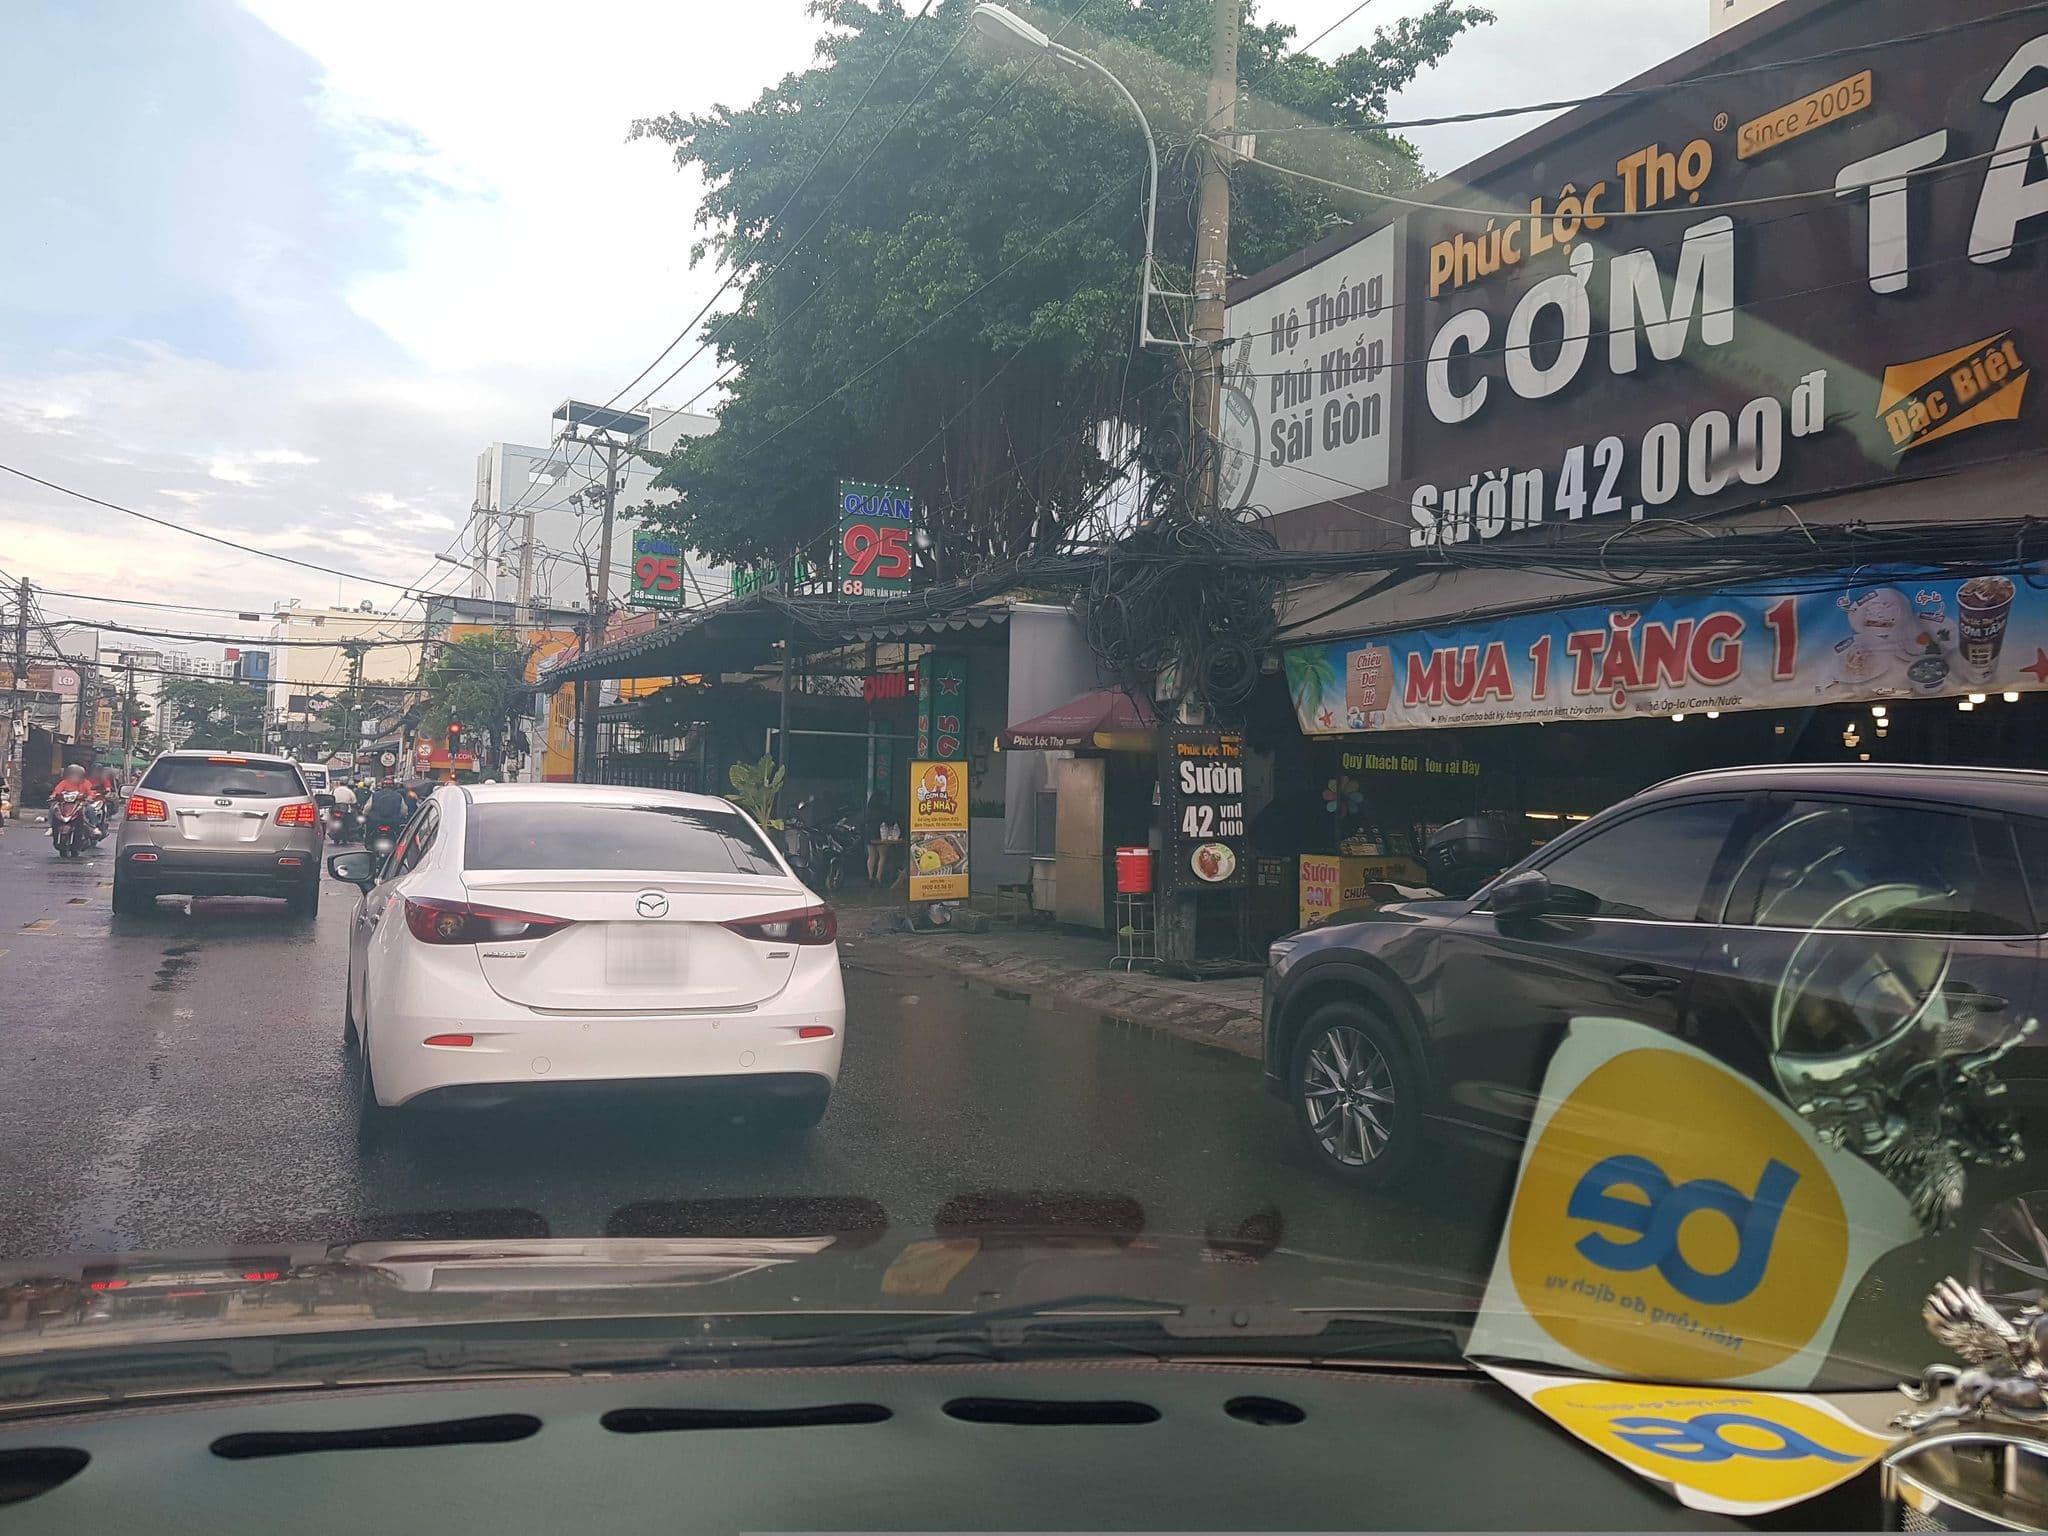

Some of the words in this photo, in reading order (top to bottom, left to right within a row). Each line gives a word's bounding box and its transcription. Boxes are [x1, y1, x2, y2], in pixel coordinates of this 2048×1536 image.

[1742, 112, 1799, 151] Since
[1804, 78, 1866, 127] 2005
[1429, 217, 1521, 298] Phúc
[1529, 182, 1606, 256] Lộc
[1616, 138, 1713, 215] Thọ
[1270, 307, 1300, 356] Hệ
[1306, 275, 1384, 340] Thống
[1426, 215, 1734, 424] CƠM
[1270, 358, 1313, 415] Phủ
[1319, 332, 1384, 397] Khắp
[1885, 387, 1949, 446] Đặc
[1951, 337, 2025, 406] Biệt
[1270, 408, 1314, 468] Sài
[1322, 392, 1382, 452] Gòn
[844, 491, 912, 520] QUÁN
[1409, 466, 1544, 548] Sườn
[635, 556, 681, 592] 95
[843, 524, 911, 578] 95
[634, 590, 645, 599] 68
[843, 580, 864, 595] 68
[1403, 640, 1516, 708] MUA
[1528, 635, 1553, 700] 1
[1565, 611, 1746, 710] TẶNG
[1765, 597, 1802, 682] 1
[937, 715, 960, 757] 95
[1013, 735, 1033, 746] Phúc
[1034, 735, 1049, 749] Lộc
[1049, 736, 1064, 748] Thọ
[1179, 760, 1243, 795] Sườn
[1342, 752, 1363, 770] Quý
[1365, 753, 1399, 771] Khách
[1400, 755, 1418, 773] Gọi
[1182, 805, 1214, 838] 42
[1302, 861, 1337, 882] Sườn
